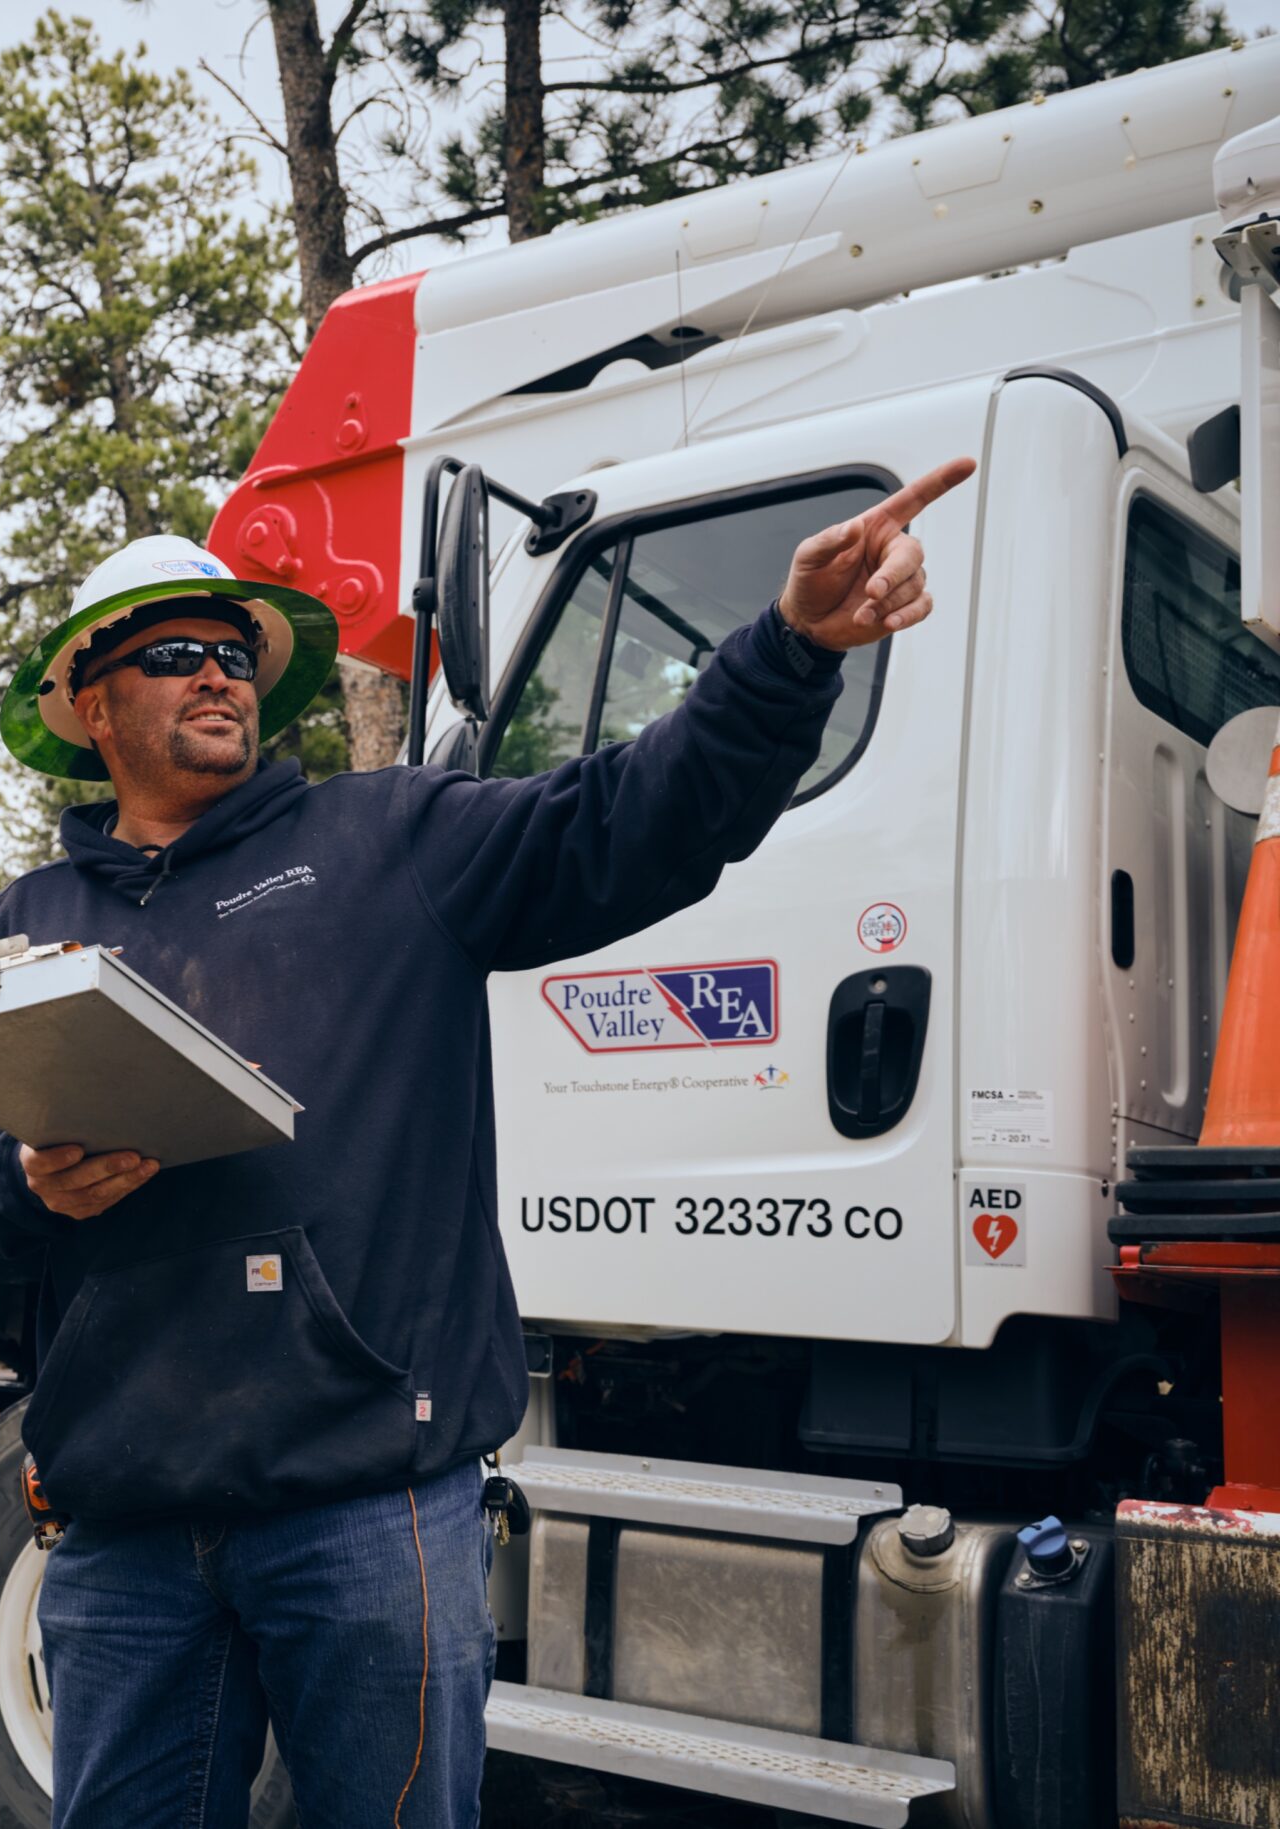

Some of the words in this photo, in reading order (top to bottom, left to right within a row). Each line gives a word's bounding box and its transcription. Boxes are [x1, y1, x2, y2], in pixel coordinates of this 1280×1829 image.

[215, 890, 253, 910] Poudre
[254, 874, 284, 891] Valley
[285, 865, 314, 877] REA
[862, 928, 896, 937] SAFETY
[563, 980, 652, 1010] Poudre
[689, 973, 770, 1037] REA
[587, 1010, 665, 1041] Valley
[543, 1082, 568, 1094] Your
[570, 1080, 629, 1093] Touchstone
[682, 1075, 749, 1090] Cooperative
[971, 1090, 1004, 1099] FMCSA
[991, 1133, 997, 1142] 2
[969, 1188, 1022, 1209] AED
[521, 1196, 656, 1234] USDOT
[674, 1197, 833, 1239] 323373
[844, 1205, 903, 1240] CO
